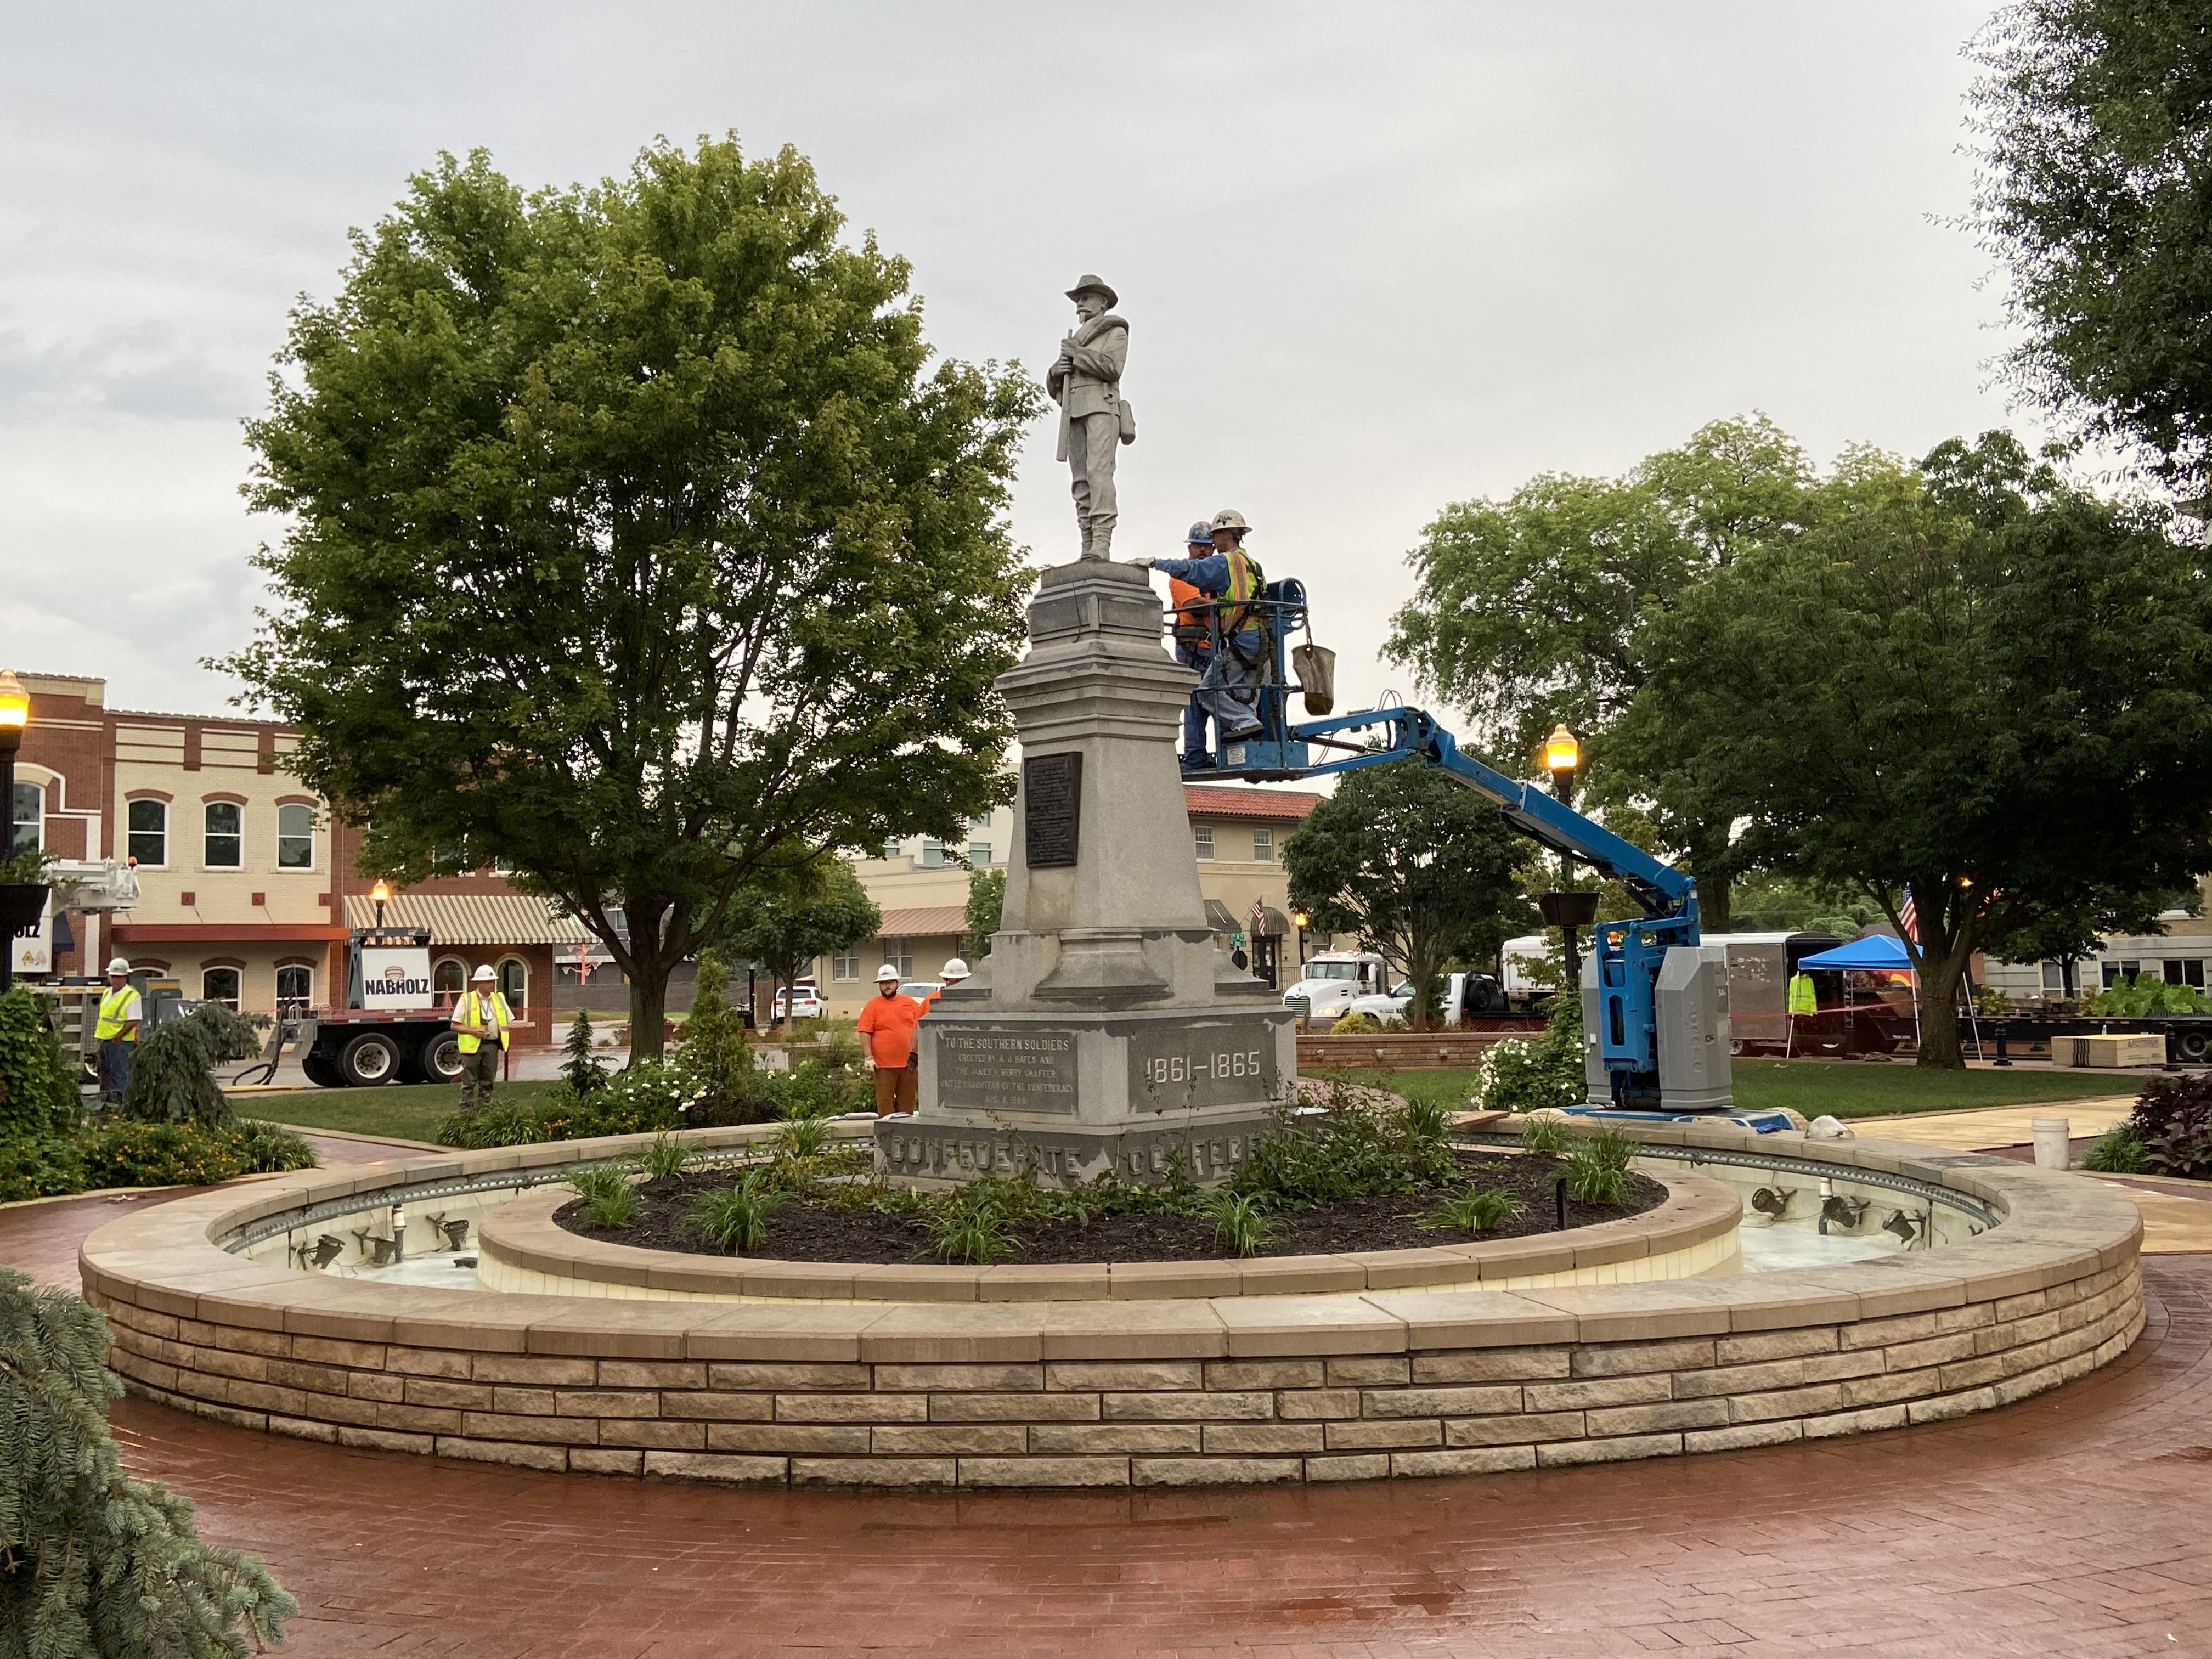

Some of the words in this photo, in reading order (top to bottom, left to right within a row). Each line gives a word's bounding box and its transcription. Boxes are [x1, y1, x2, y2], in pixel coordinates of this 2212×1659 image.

[365, 979, 430, 995] NABHOLZ
[945, 1037, 956, 1049] TO
[958, 1037, 974, 1049] THE
[977, 1038, 1023, 1050] SOUTHERN
[1024, 1039, 1069, 1051] SOLDIERS
[958, 1054, 986, 1063] ERECTED
[988, 1054, 995, 1063] BY
[956, 1066, 968, 1075] THE
[1147, 1049, 1260, 1084] 1861-1865
[963, 1080, 1000, 1090] DAUGHTERS
[1002, 1081, 1011, 1090] OF
[1012, 1082, 1025, 1091] THE
